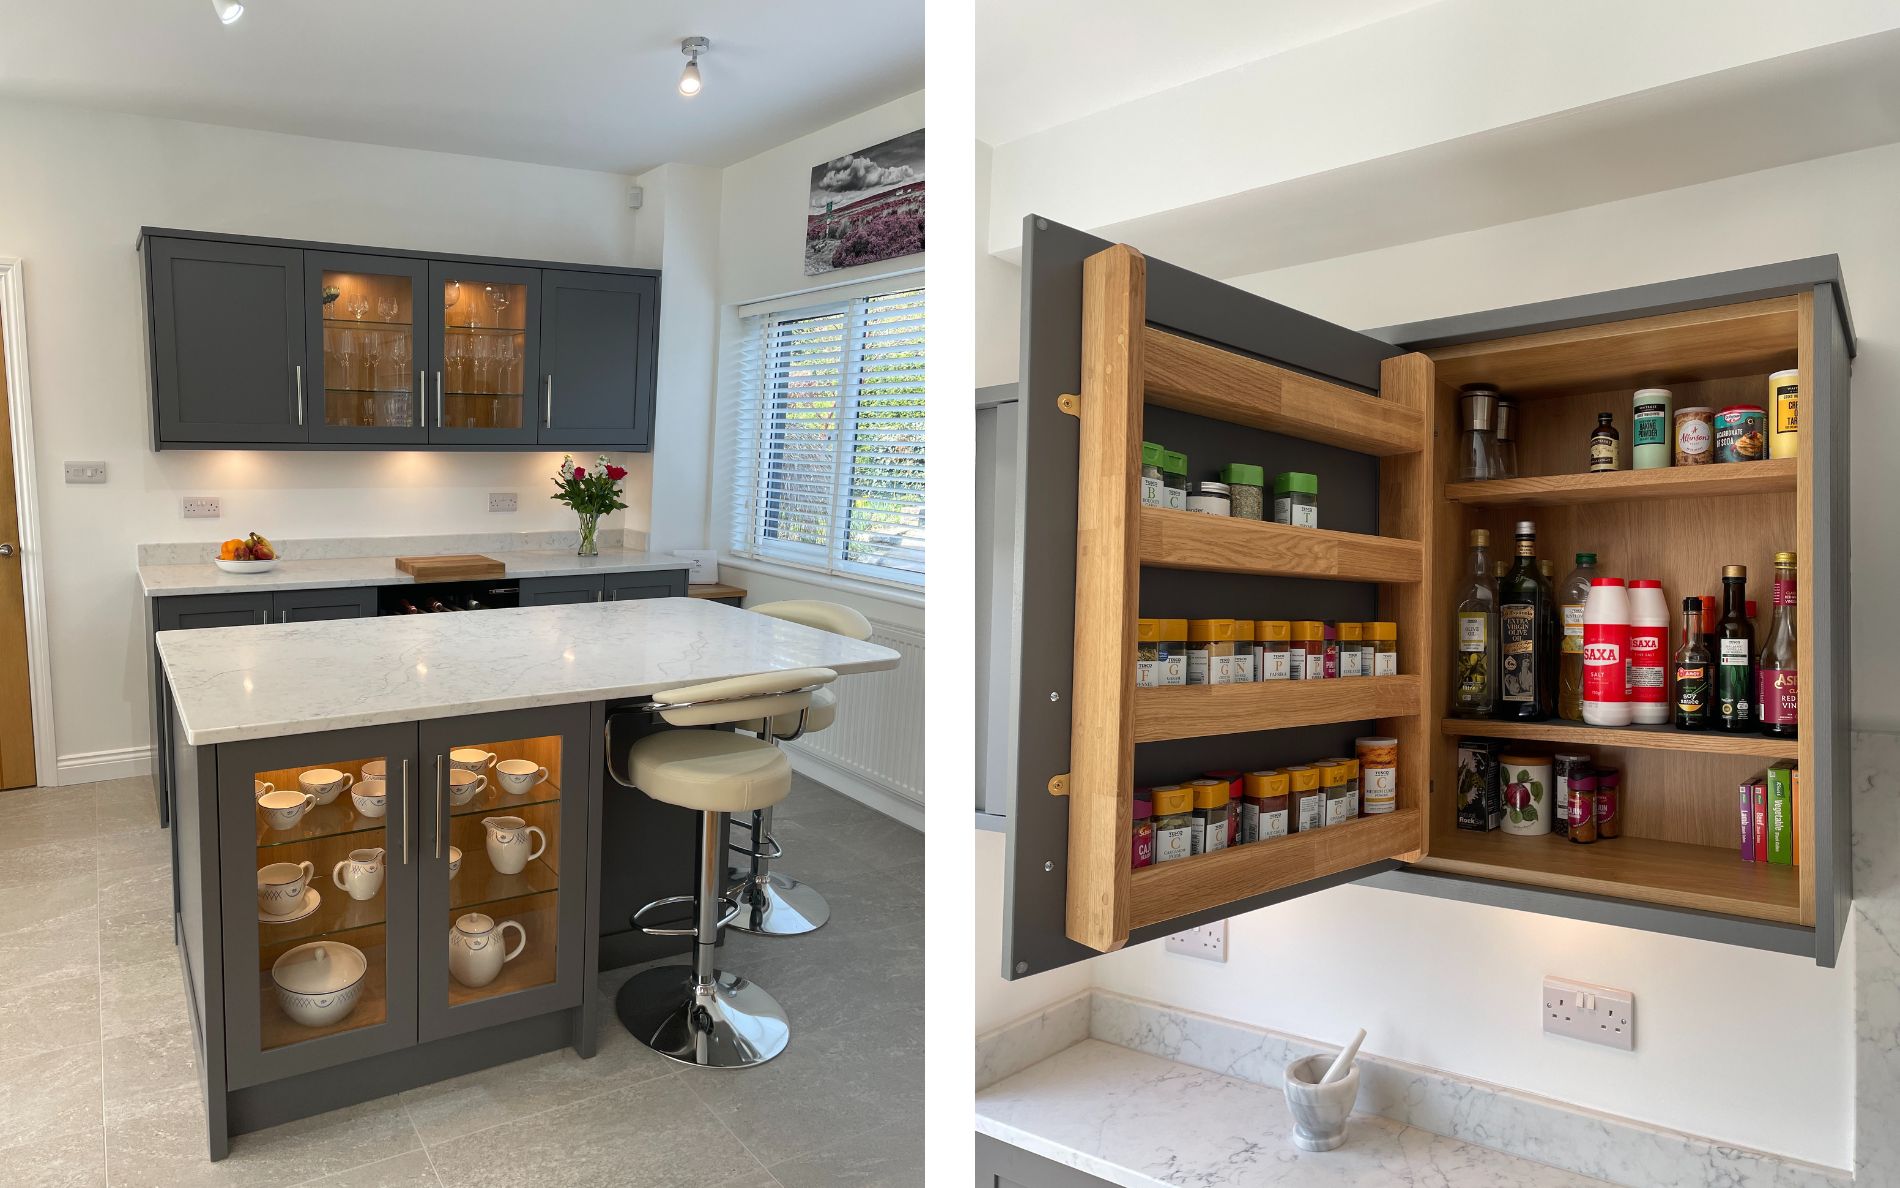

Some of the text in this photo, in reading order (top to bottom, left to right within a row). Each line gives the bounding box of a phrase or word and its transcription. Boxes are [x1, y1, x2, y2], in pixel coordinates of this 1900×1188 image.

[1148, 487, 1156, 499] B
[1170, 497, 1179, 508] C
[1303, 512, 1311, 523] T
[1632, 640, 1657, 648] SAXA
[1584, 649, 1617, 661] SAXA
[1236, 663, 1245, 674] N
[1275, 660, 1283, 671] P
[1315, 661, 1320, 672] P
[1350, 658, 1356, 668] S
[1384, 659, 1391, 669] T
[1169, 663, 1179, 676] G
[1220, 663, 1229, 676] G
[1141, 669, 1150, 682] F
[1376, 776, 1387, 789] C
[1335, 804, 1342, 815] C
[1773, 799, 1784, 831] Vegetable
[1459, 816, 1475, 824] Rock
[1741, 810, 1749, 826] Lamb
[1756, 812, 1764, 827] Beef
[1271, 819, 1280, 830] C
[1215, 830, 1223, 842] C
[1170, 837, 1181, 849] C
